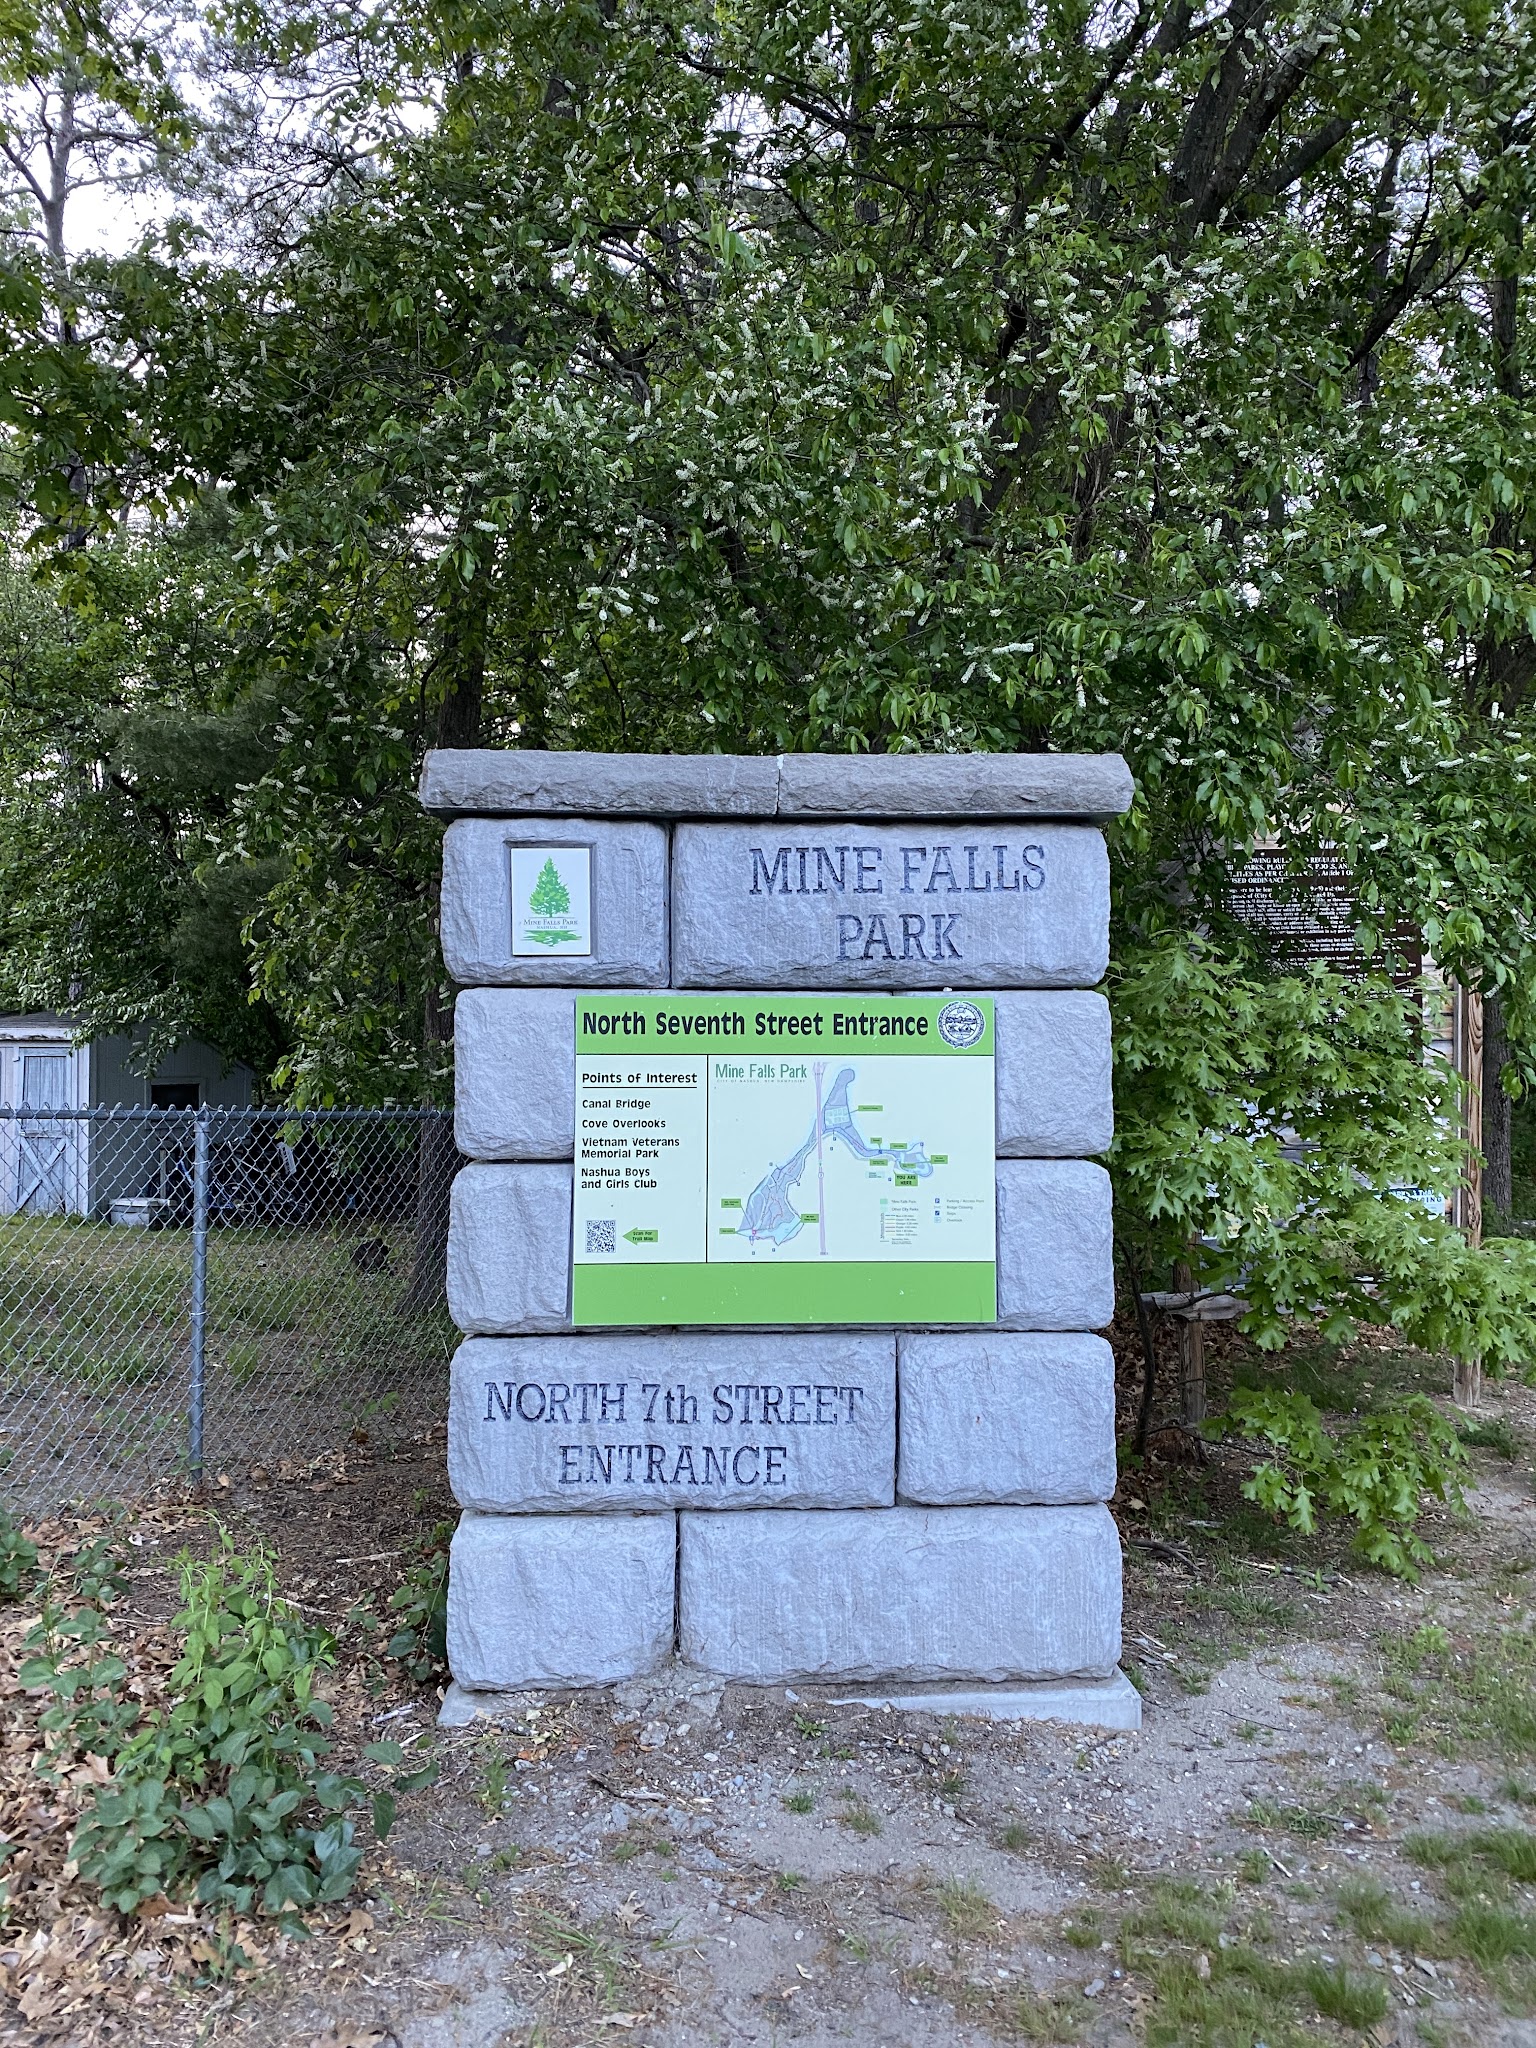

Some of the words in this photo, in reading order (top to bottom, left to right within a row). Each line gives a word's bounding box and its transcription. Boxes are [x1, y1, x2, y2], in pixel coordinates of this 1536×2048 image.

[749, 845, 882, 895] MINE
[900, 844, 1046, 894] FALLS
[835, 913, 963, 961] PARK
[583, 1011, 646, 1036] North
[655, 1011, 745, 1036] Seventh
[755, 1011, 823, 1036] Street
[833, 1011, 929, 1036] Entrance
[715, 1063, 745, 1079] Mine
[749, 1063, 775, 1079] Falls
[780, 1063, 808, 1079] Park
[582, 1072, 622, 1084] Points
[627, 1073, 641, 1084] of
[646, 1072, 698, 1084] Interest
[582, 1099, 611, 1109] Canal
[616, 1099, 651, 1110] Bridge
[582, 1119, 608, 1128] Cove
[612, 1119, 666, 1128] Overlooks
[582, 1137, 628, 1147] Vietnam
[632, 1137, 680, 1147] Veterans
[581, 1149, 631, 1158] Memorial
[635, 1149, 659, 1158] Park
[581, 1168, 621, 1177] Nashua
[625, 1168, 650, 1178] Boys
[581, 1179, 602, 1189] and
[606, 1179, 630, 1189] Girls
[634, 1179, 657, 1189] Club
[483, 1382, 629, 1424] NORTH
[641, 1383, 699, 1424] 7th
[712, 1384, 864, 1425] STREET
[558, 1445, 788, 1486] ENTRANCE
